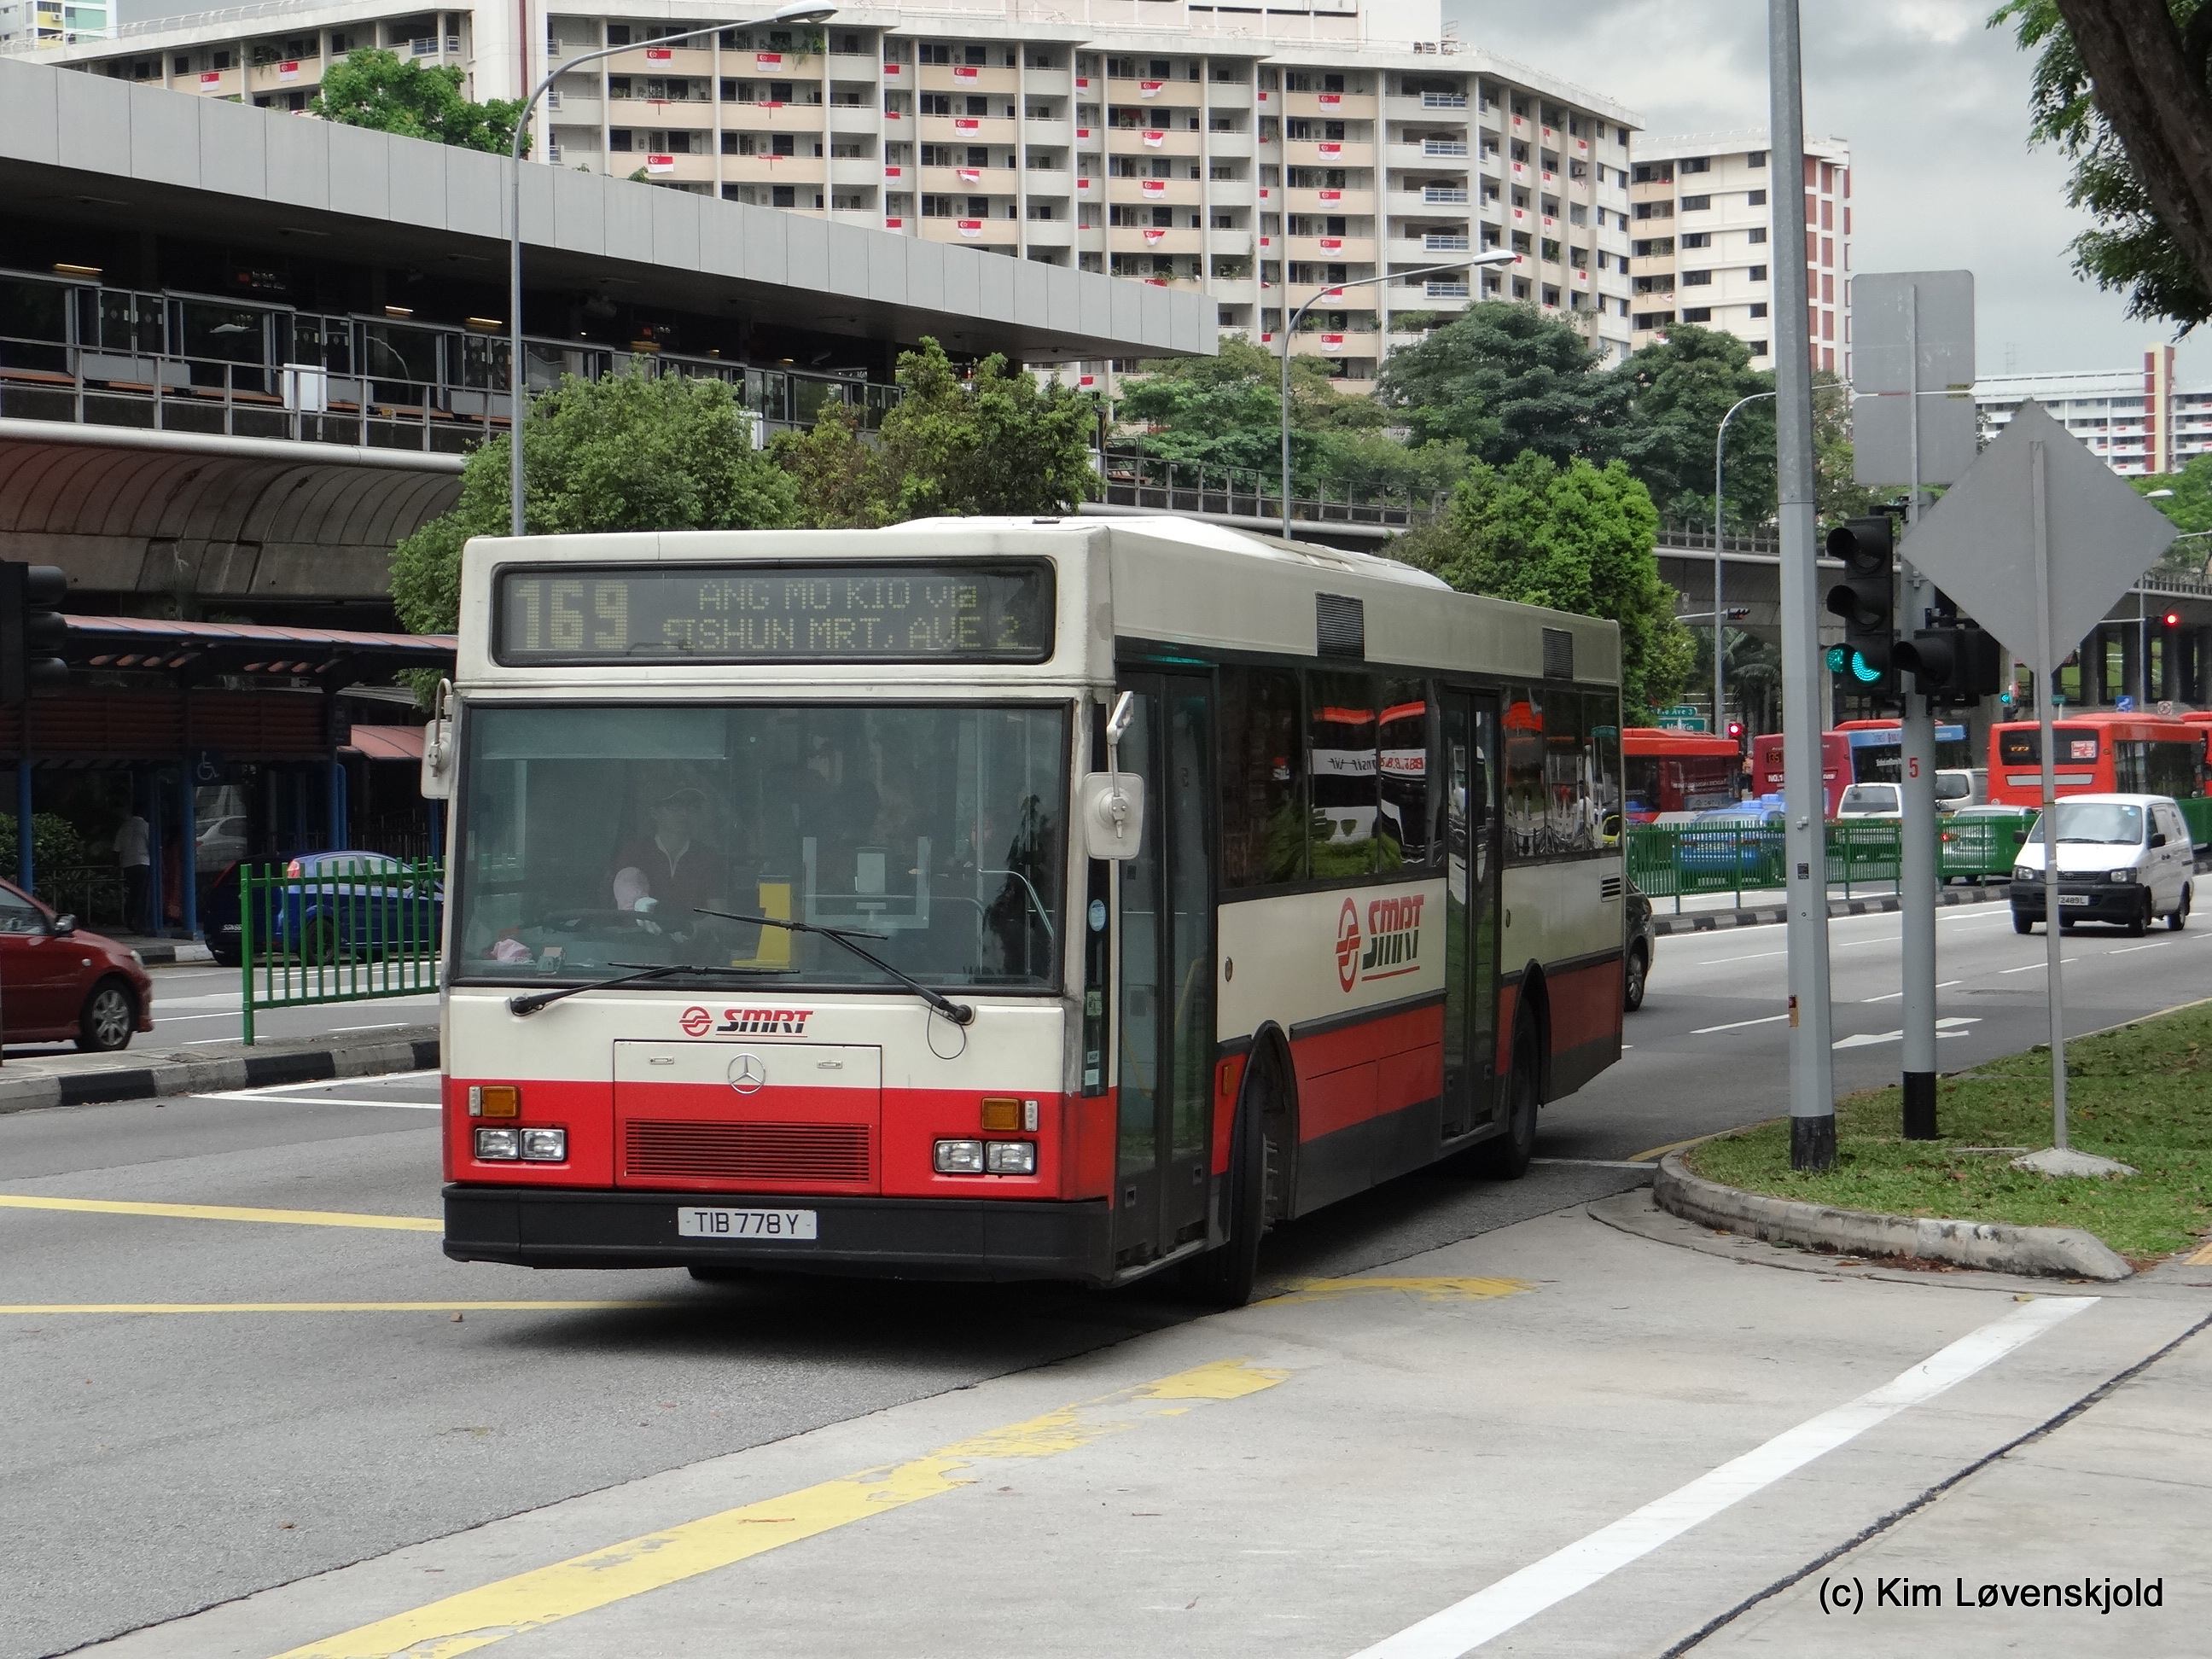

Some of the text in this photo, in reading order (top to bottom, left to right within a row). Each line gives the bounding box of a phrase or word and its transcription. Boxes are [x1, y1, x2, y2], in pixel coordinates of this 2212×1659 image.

[699, 579, 771, 610] ANG
[783, 579, 832, 609] MO
[847, 578, 911, 608] KIO
[515, 579, 629, 649] 169
[910, 616, 981, 649] AVE
[997, 614, 1019, 648] 2
[1908, 757, 1919, 778] 5
[1361, 894, 1425, 971] SMRT
[716, 1009, 814, 1033] SMRT
